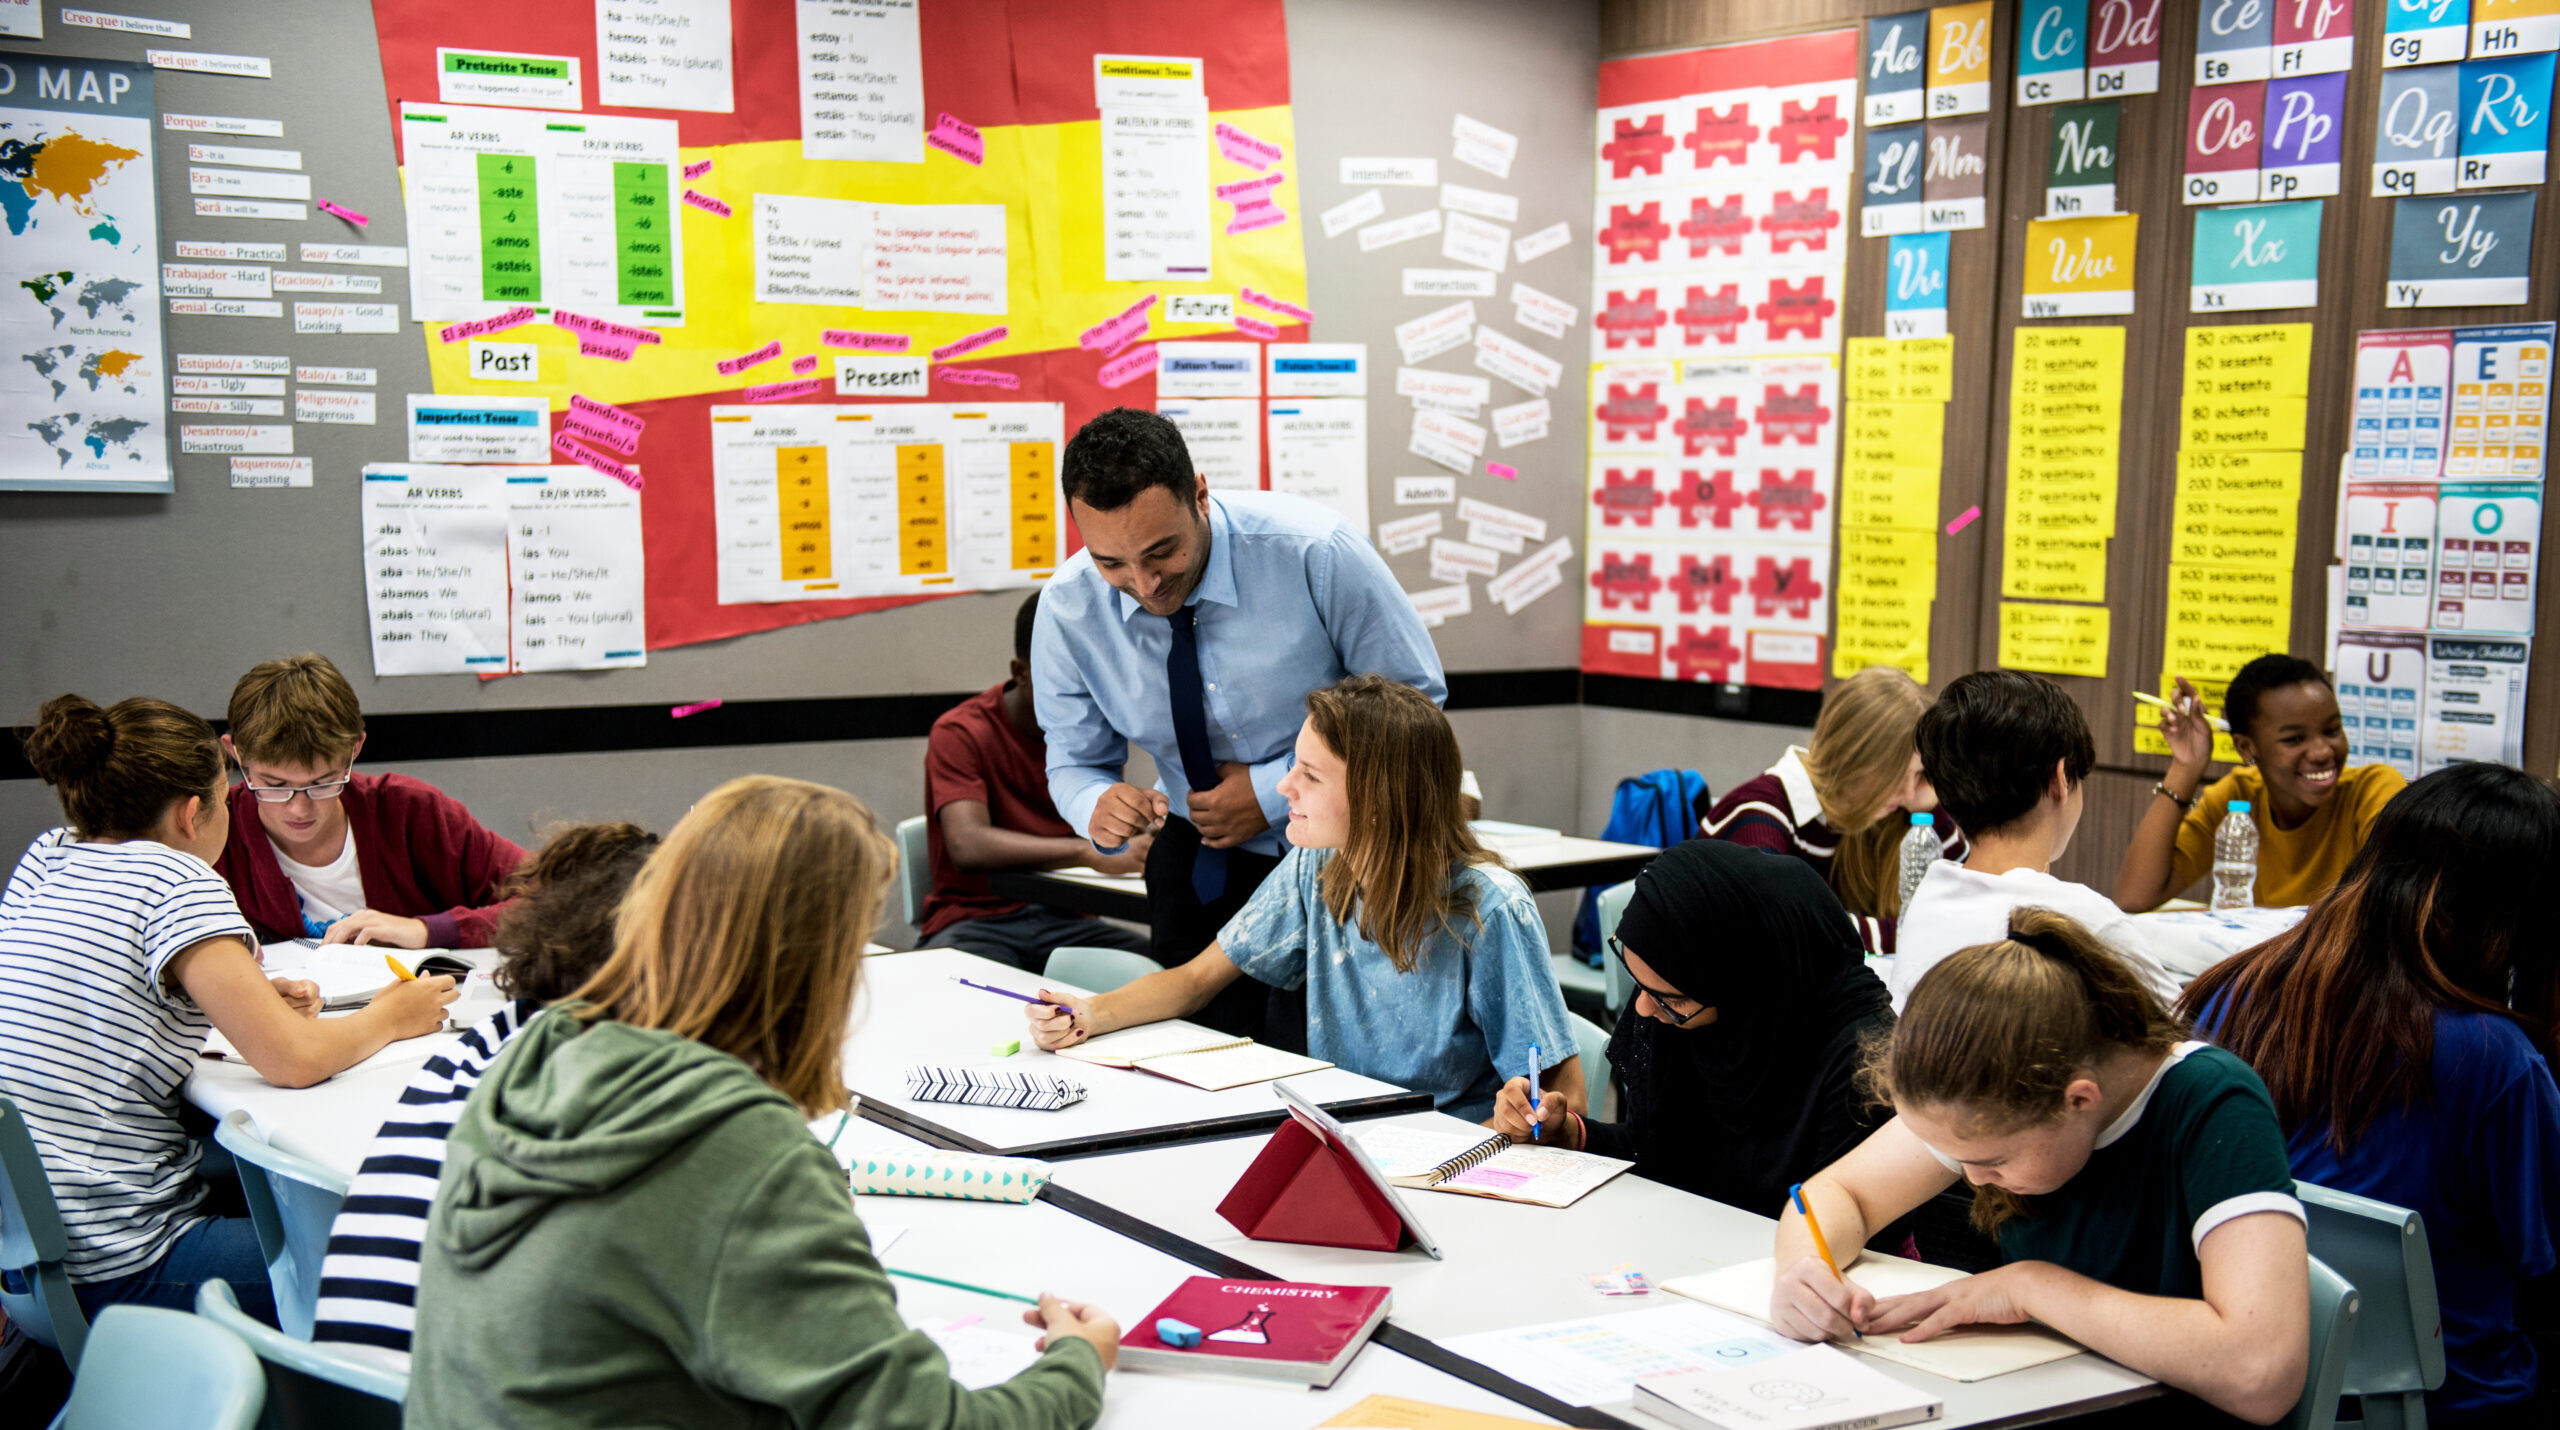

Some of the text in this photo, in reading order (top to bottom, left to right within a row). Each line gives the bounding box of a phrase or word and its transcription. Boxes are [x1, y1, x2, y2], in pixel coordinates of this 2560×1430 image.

[64, 10, 93, 24] Creo
[96, 17, 119, 29] que
[126, 20, 154, 32] believe
[156, 23, 172, 33] that
[2097, 0, 2159, 53] Dd
[2032, 6, 2076, 61] Cc
[2484, 27, 2518, 50] Hh
[1871, 24, 1921, 79] Aa
[1938, 18, 1987, 75] Bb
[2391, 36, 2422, 62] Gg
[177, 58, 198, 69] que
[456, 59, 557, 76] Preterite Tense
[2205, 59, 2229, 78] Ee
[2282, 50, 2303, 71] Ff
[39, 66, 131, 104] MAP
[2026, 81, 2051, 99] Cc
[2097, 72, 2124, 92] Dd
[1936, 95, 1958, 110] Bb
[2471, 73, 2539, 136] Rr
[165, 115, 246, 131] Porque because
[2196, 97, 2255, 155] Oo
[2273, 90, 2331, 160] Pp
[2385, 87, 2456, 158] Qq
[190, 147, 203, 158] Es
[2056, 119, 2115, 175] Nn
[1868, 140, 1919, 195] Ll
[1925, 135, 1985, 182] Mm
[192, 171, 211, 183] Era
[2465, 160, 2491, 181] Rr
[2189, 178, 2219, 196] Oo
[2271, 173, 2298, 200] Pp
[2383, 169, 2415, 195] Qq
[195, 201, 221, 212] Será
[2056, 195, 2081, 213] Nn
[1932, 209, 1965, 224] Mm
[2229, 218, 2287, 270] Xx
[2437, 204, 2499, 268] Yy
[236, 248, 285, 260] Practical
[301, 248, 329, 260] Guay
[2049, 237, 2117, 283] Ww
[164, 267, 227, 281] Trabajador
[273, 274, 380, 289] Gracioso/a Funny
[164, 284, 213, 297] working
[2204, 292, 2226, 307] Xx
[2397, 284, 2423, 308] Yy
[170, 301, 207, 313] Genial
[297, 304, 383, 317] Guapo/a Good
[1173, 298, 1230, 317] Future
[2030, 300, 2059, 317] Ww
[70, 326, 132, 338] North America
[298, 320, 342, 334] Looking
[441, 307, 535, 342] El año pasado
[554, 310, 662, 345] El fin de semana
[1894, 319, 1915, 334] Vv
[481, 349, 531, 372] Past
[581, 342, 629, 361] pasado
[179, 358, 289, 372] Estúpido/a Stupid
[2388, 349, 2415, 383] A
[2478, 346, 2499, 381] E
[297, 369, 366, 382] Malo/a Bad
[845, 367, 921, 388] Present
[174, 378, 246, 392] Feo/a Ugly
[173, 400, 254, 414] Tonto/a Silly
[296, 393, 359, 406] Peligroso/a
[296, 408, 355, 422] Dangerous
[417, 411, 519, 424] Imperfect Tense
[570, 394, 643, 432] Cuando era
[182, 426, 258, 438] Desastroso/a
[183, 441, 244, 452] Disastrous
[555, 434, 572, 450] De
[231, 459, 302, 471] Asqueroso/a
[231, 474, 291, 487] Disgusting
[407, 488, 464, 499] AR VERBS
[573, 488, 607, 499] VERBS
[2381, 502, 2400, 534] I
[2472, 502, 2504, 535] O
[2367, 652, 2391, 683] U
[1221, 1285, 1339, 1299] CHEMISTRY
